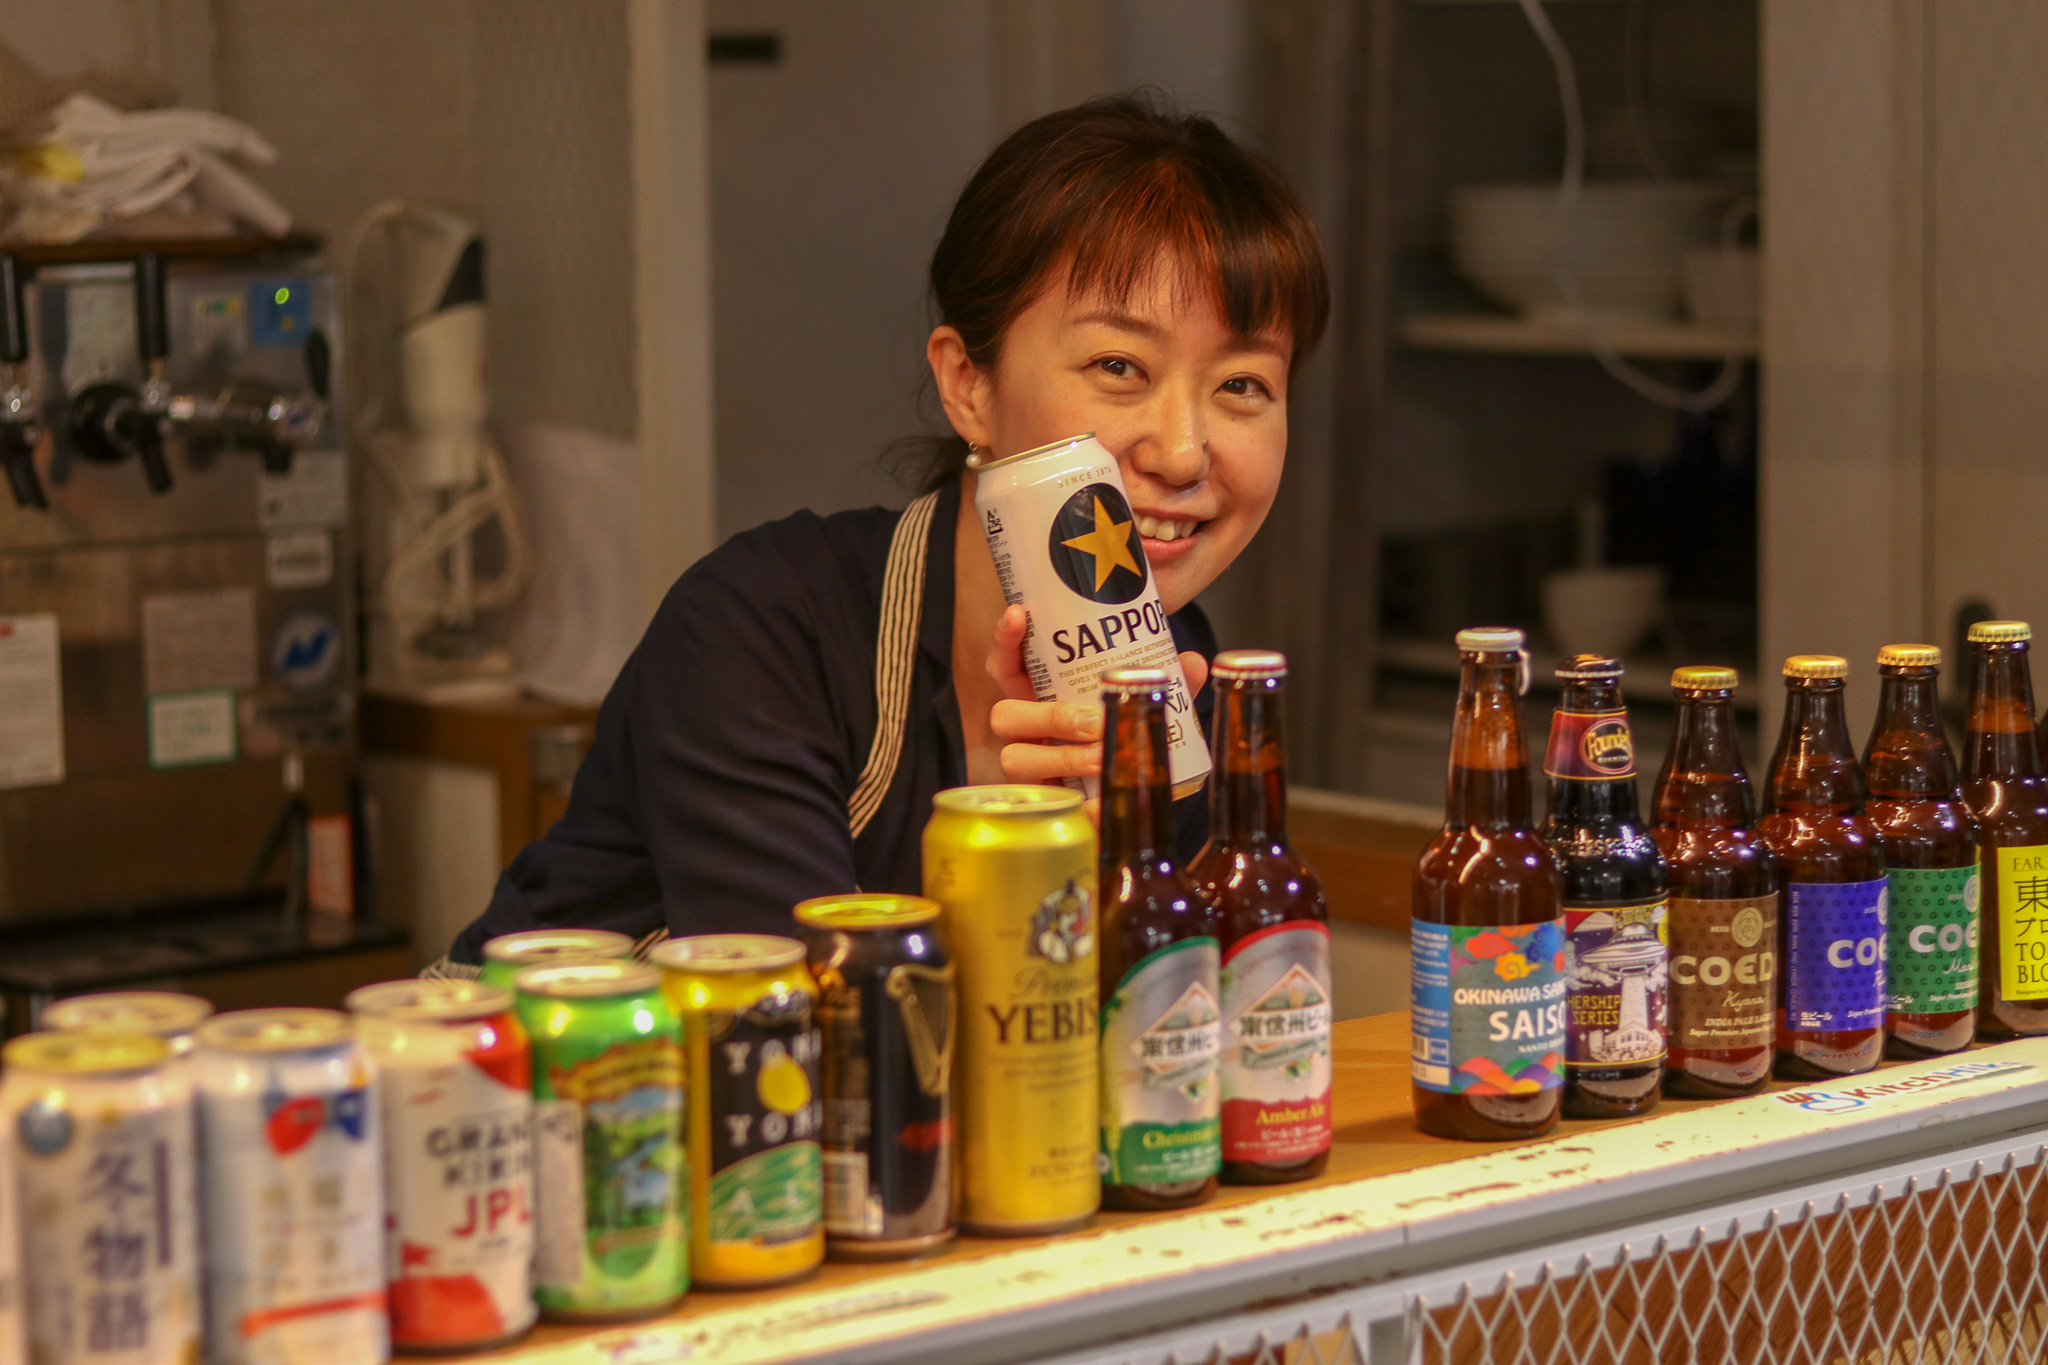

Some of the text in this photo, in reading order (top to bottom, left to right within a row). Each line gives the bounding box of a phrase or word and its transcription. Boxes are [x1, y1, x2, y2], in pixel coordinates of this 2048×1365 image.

[1057, 471, 1092, 489] SINCE
[1076, 658, 1109, 674] PERFECT
[1110, 647, 1144, 663] BALANCE
[1068, 674, 1091, 687] GIVES
[1077, 683, 1099, 695] FROM
[1453, 986, 1541, 1006] OKINAWA
[986, 997, 1099, 1044] YEBIS
[1573, 1010, 1620, 1025] SERIES
[1705, 1018, 1732, 1027] INDIA
[1734, 1016, 1754, 1026] PALE
[1689, 1028, 1710, 1037] Super
[1710, 1026, 1740, 1036] Premium
